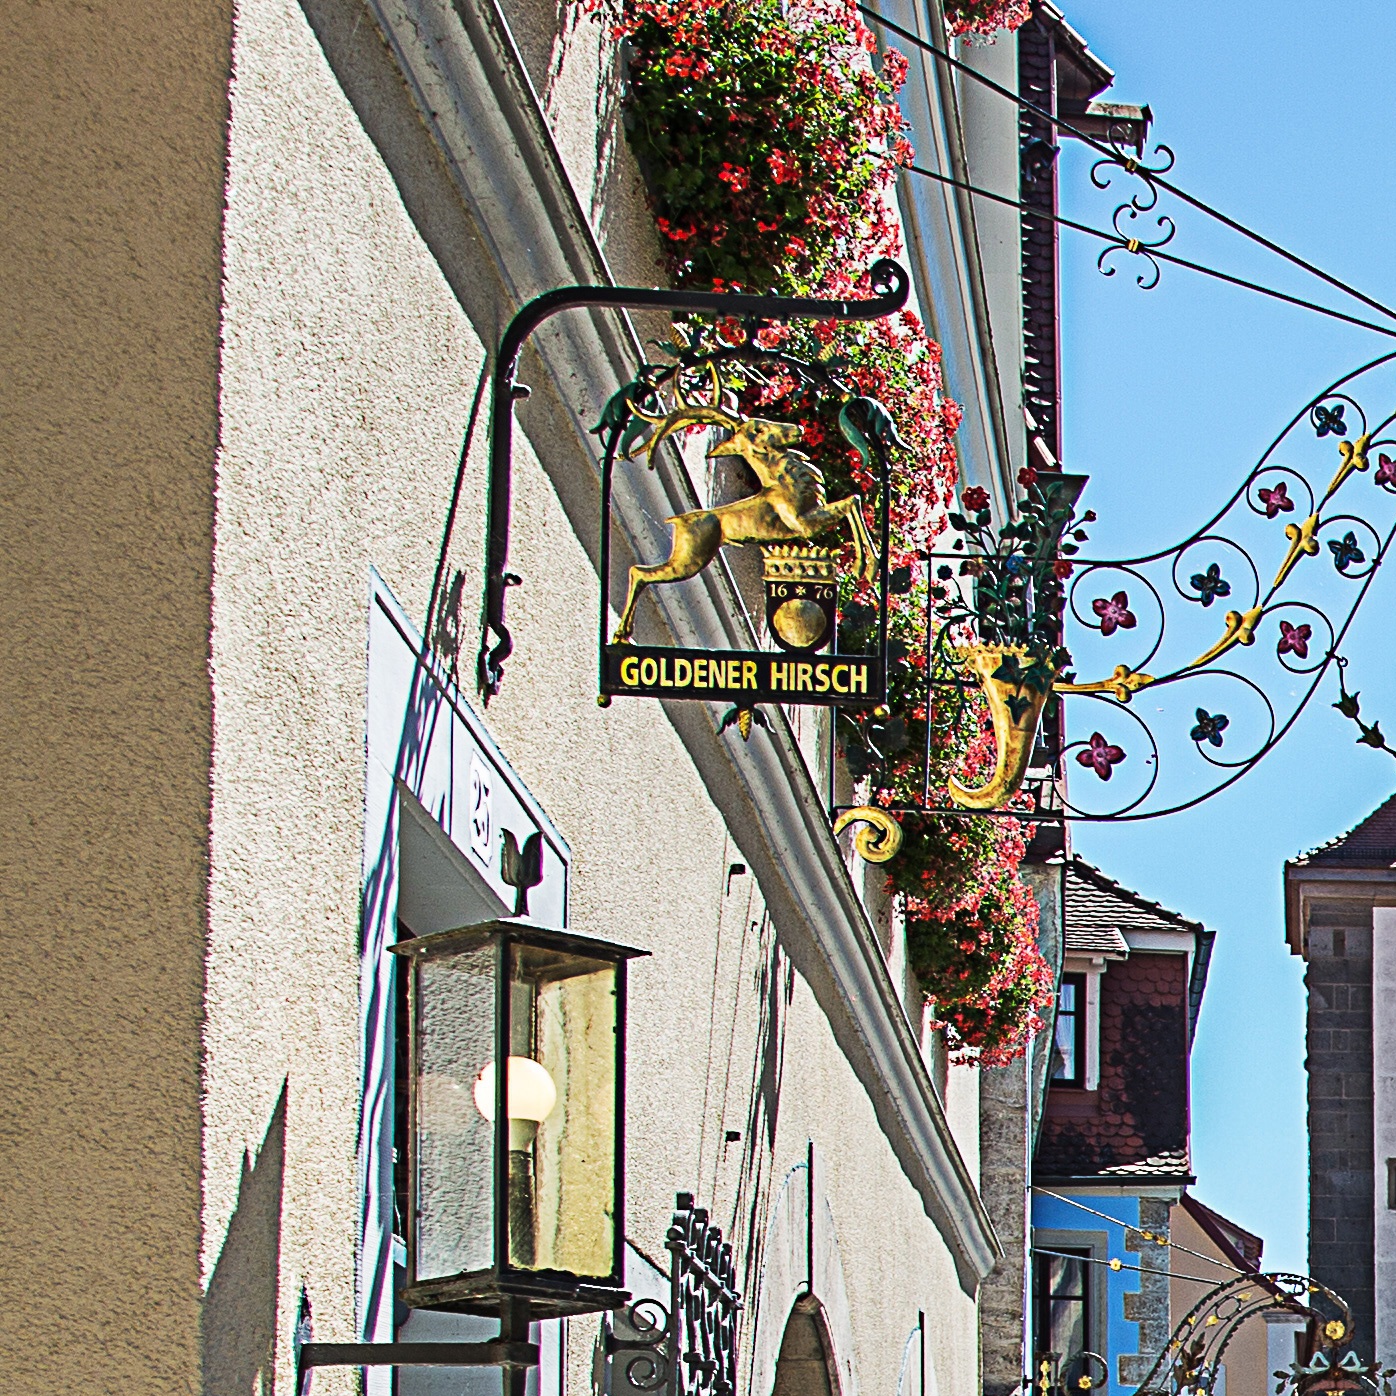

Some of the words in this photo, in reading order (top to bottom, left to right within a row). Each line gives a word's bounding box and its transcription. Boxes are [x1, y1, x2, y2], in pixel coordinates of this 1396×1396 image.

[770, 583, 788, 598] 16
[814, 585, 834, 600] 76
[620, 656, 758, 690] GOLDENER
[770, 661, 869, 694] HIRSCH
